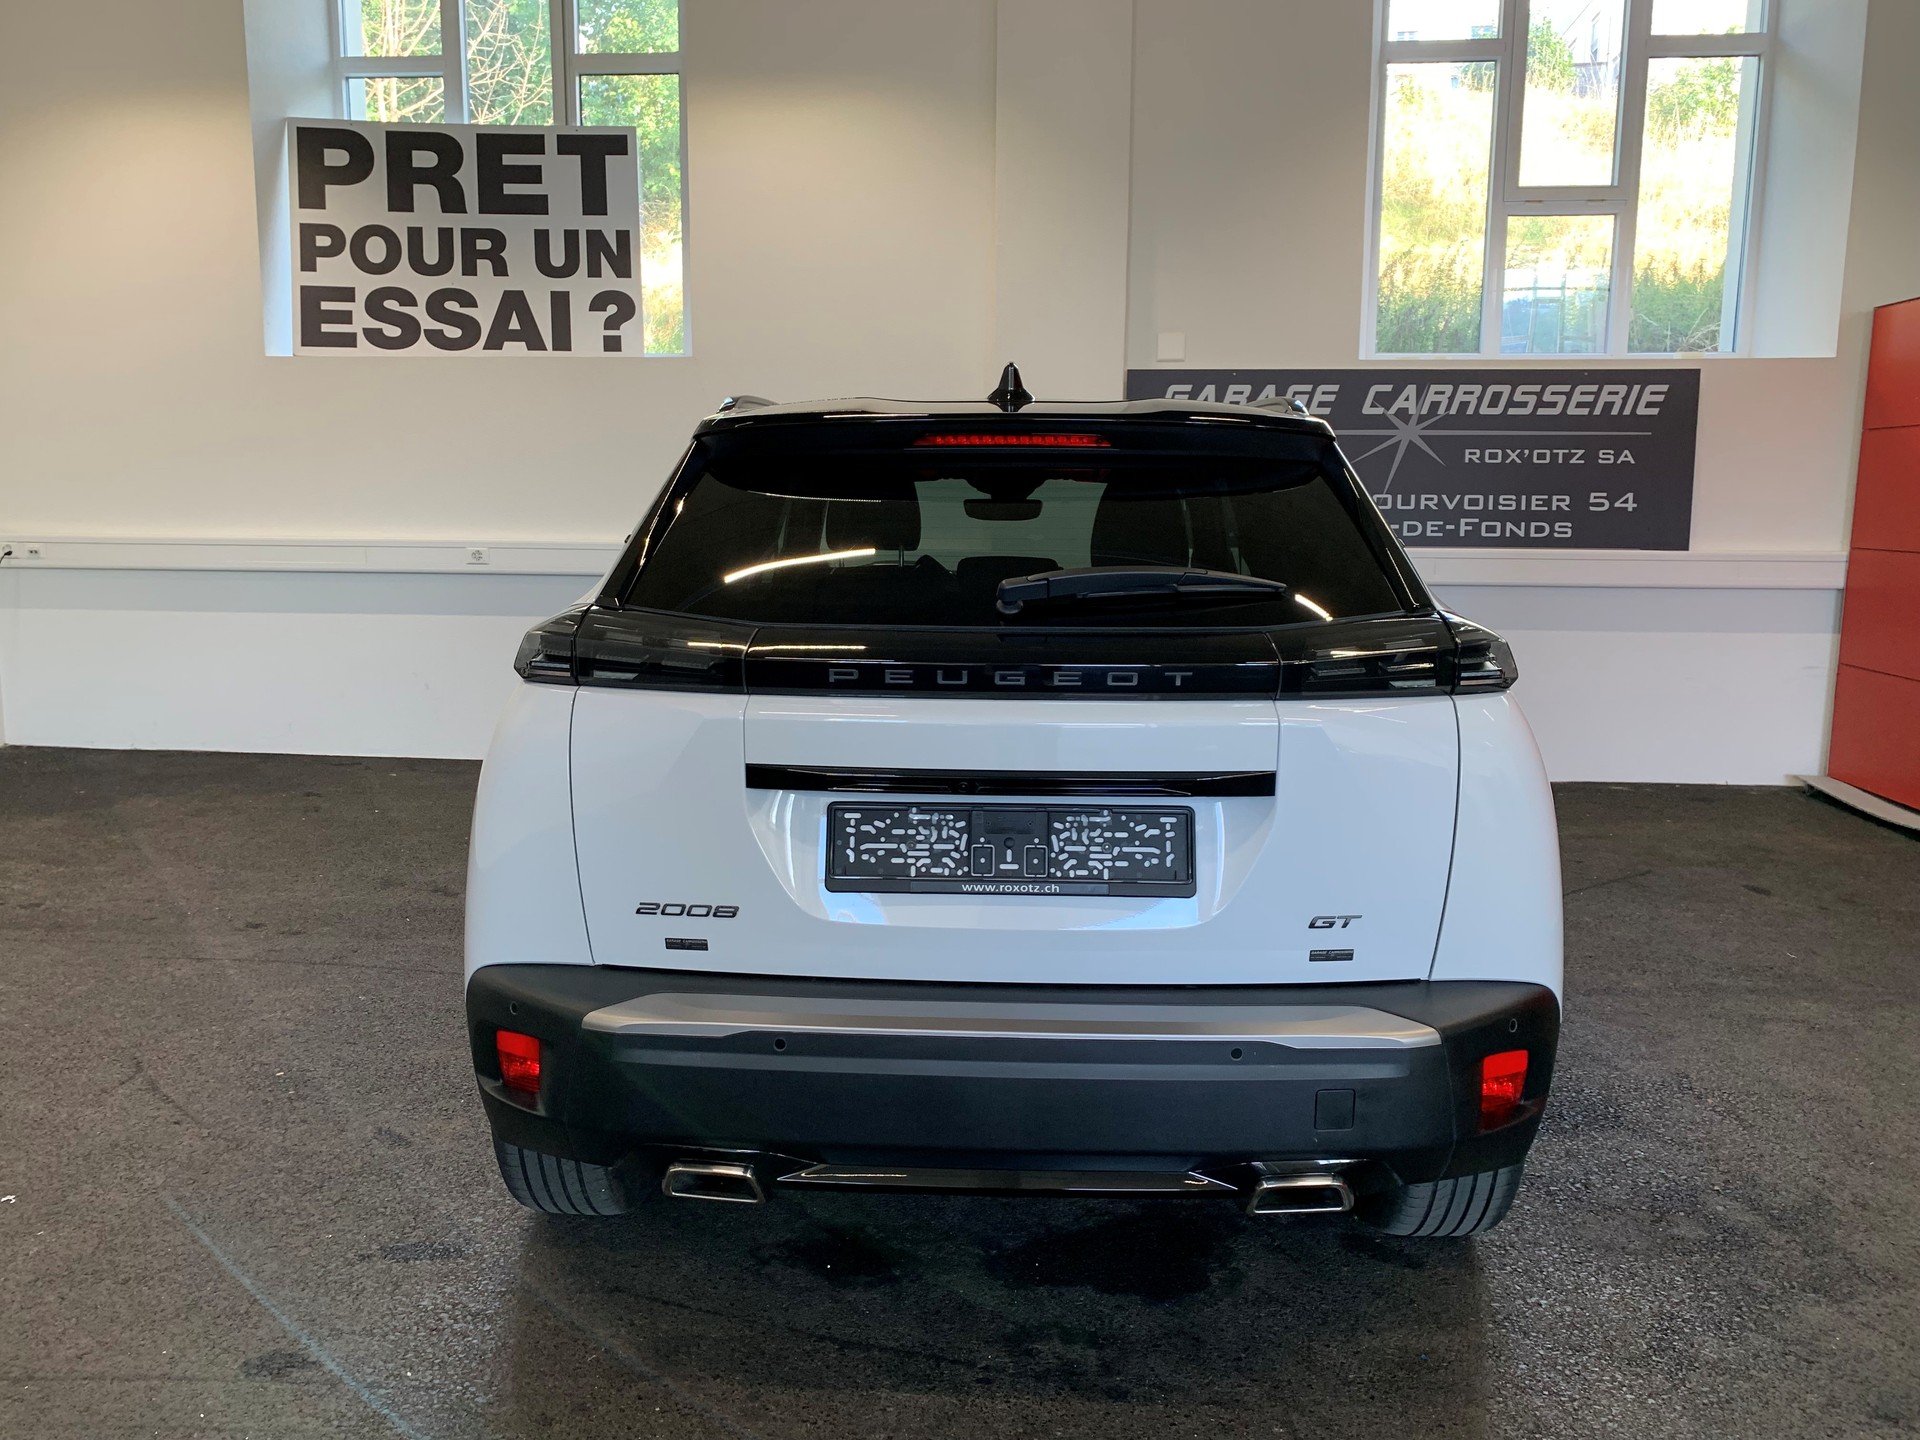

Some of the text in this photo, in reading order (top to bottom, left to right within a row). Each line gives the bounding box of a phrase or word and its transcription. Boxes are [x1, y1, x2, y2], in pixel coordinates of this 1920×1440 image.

[297, 127, 628, 216] PRET
[300, 223, 631, 278] POUR UN
[1362, 384, 1669, 416] CARROSSERIE
[1464, 449, 1635, 464] ROX'OTZ SA
[1589, 492, 1637, 512] 54
[828, 668, 1193, 687] PEUGEOT
[962, 883, 1060, 894] www.roxotz.ch
[635, 902, 739, 918] 2008
[1308, 915, 1363, 929] GT
